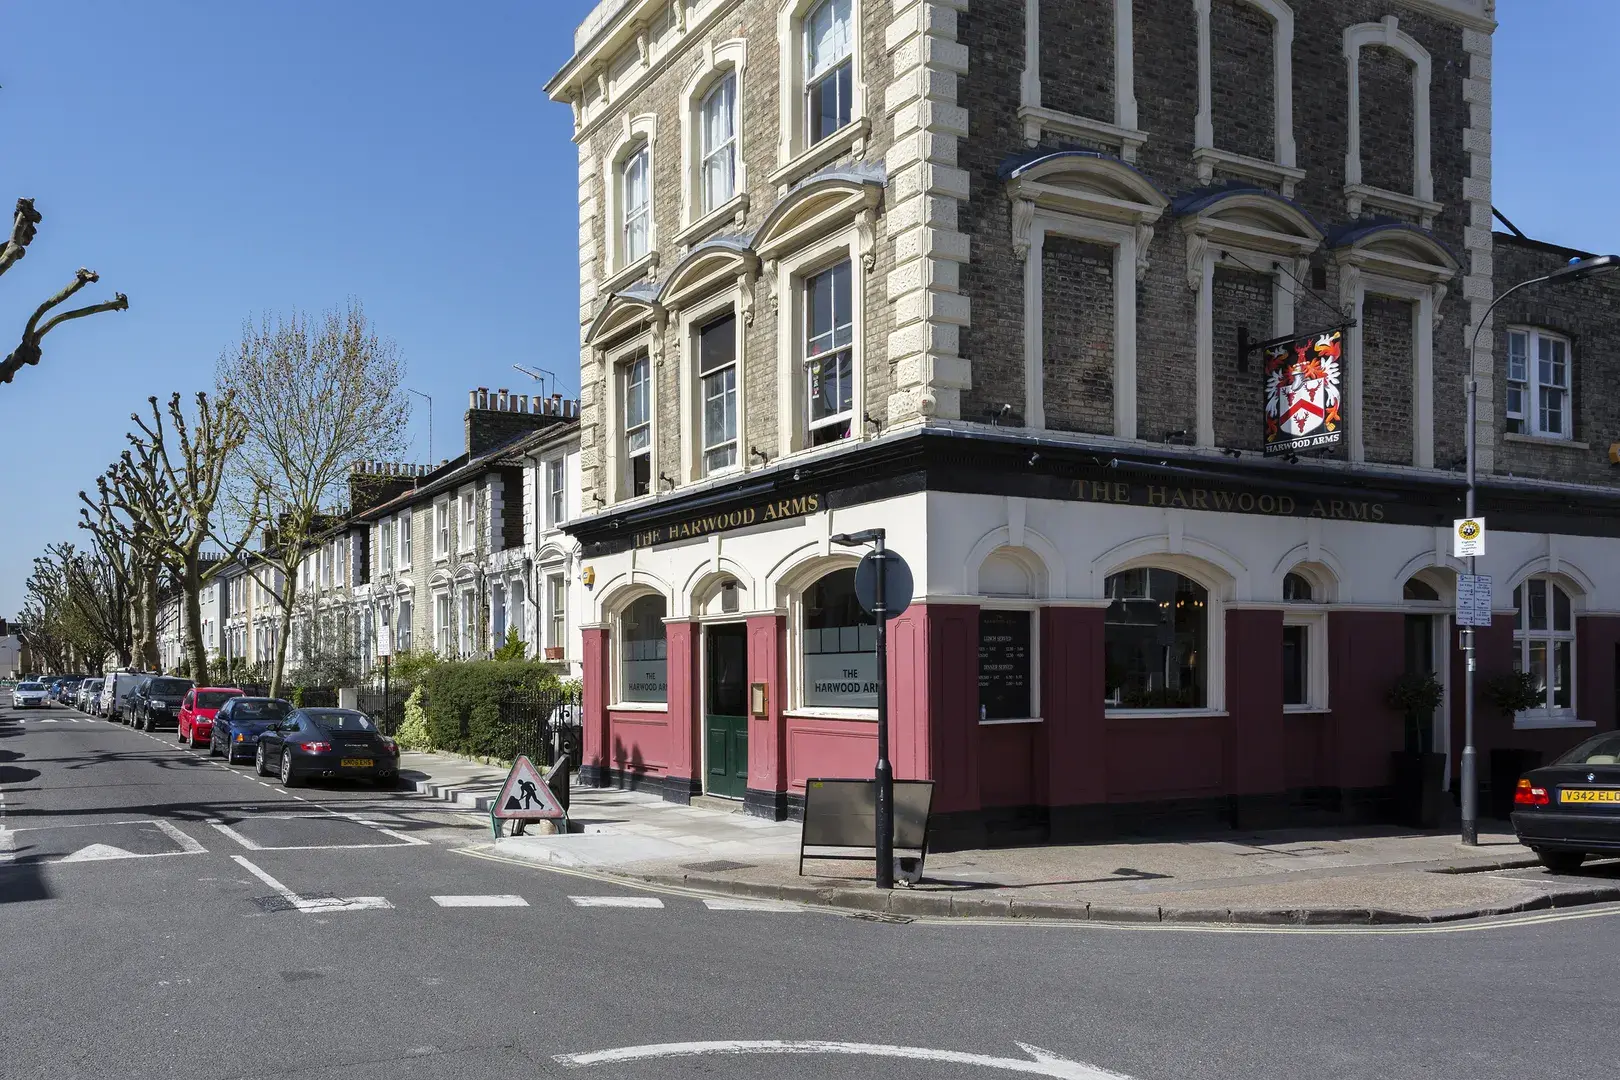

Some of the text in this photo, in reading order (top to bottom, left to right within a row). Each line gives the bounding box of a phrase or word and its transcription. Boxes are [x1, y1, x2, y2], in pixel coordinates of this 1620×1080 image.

[1266, 433, 1340, 453] HARWOOD ARMS
[1070, 478, 1385, 521] THE HARWOOD ARMS
[634, 493, 819, 547] THE HARWOOD ARMS
[646, 672, 656, 680] THE
[842, 669, 858, 678] THE
[628, 683, 668, 691] HARWOOD AR
[815, 682, 860, 693] HARWOOD
[1566, 791, 1595, 801] V342
